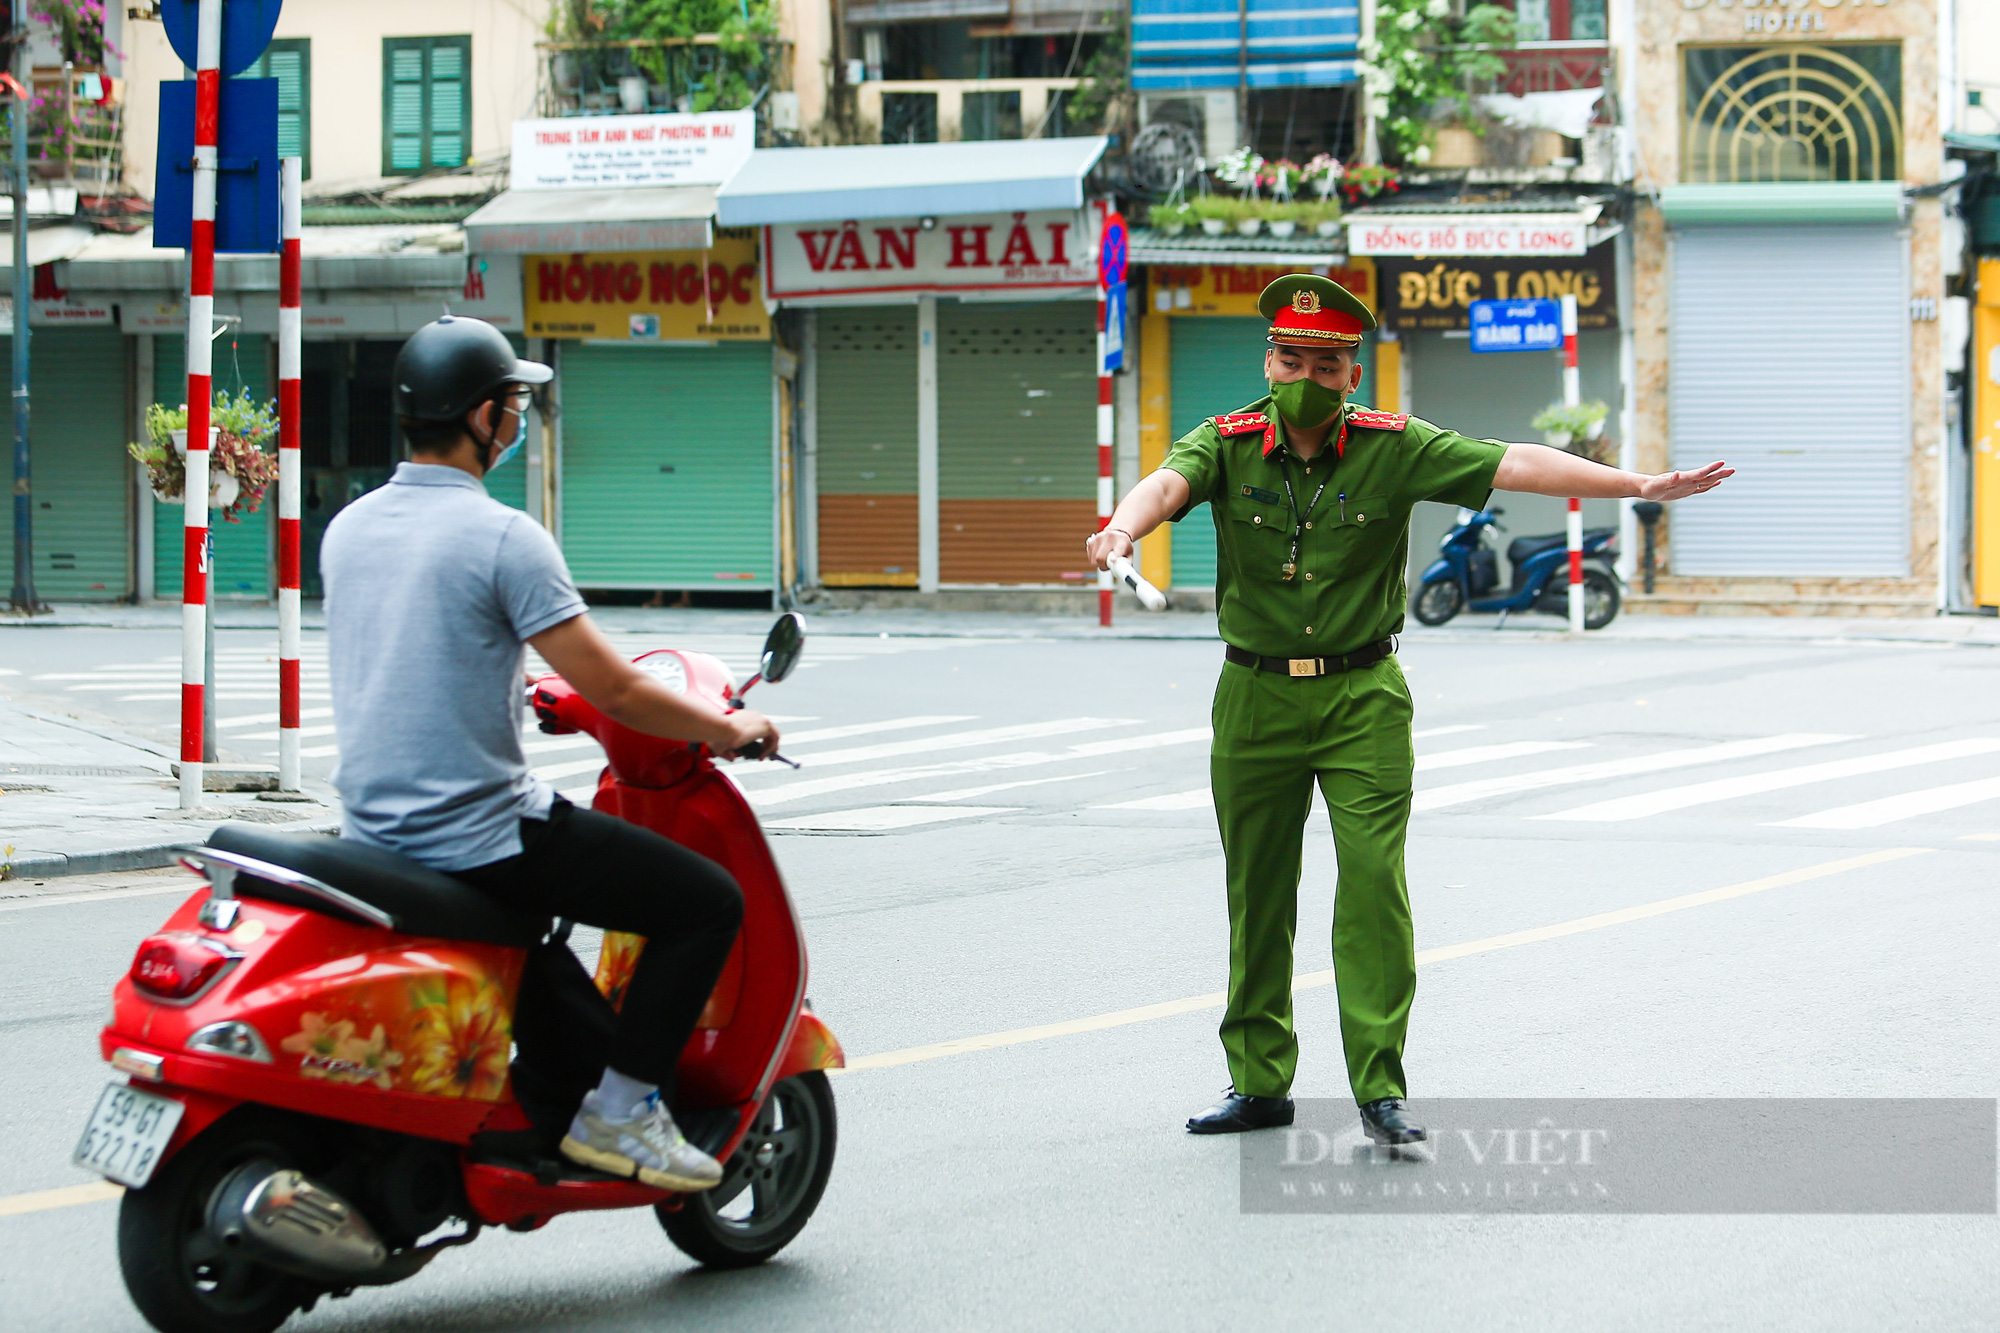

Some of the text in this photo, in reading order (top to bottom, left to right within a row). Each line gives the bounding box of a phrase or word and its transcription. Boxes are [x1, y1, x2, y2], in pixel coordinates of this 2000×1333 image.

[1745, 12, 1827, 33] HOTEL
[535, 131, 571, 145] TRUNG
[577, 128, 599, 144] TÂM
[605, 129, 627, 142] ANH
[712, 124, 735, 138] MAI
[797, 211, 1070, 272] VÂN HẢI
[1366, 225, 1573, 249] ĐỒNG HỒ ĐỨC LONG
[537, 253, 643, 304] HỒNG
[650, 262, 757, 316] NGỌC
[1398, 263, 1481, 309] ĐỨC
[1494, 269, 1601, 307] LONG
[1507, 305, 1536, 318] PHỐ
[1478, 322, 1557, 344] HÀNG ĐÀO
[105, 1090, 166, 1138] 59-G1
